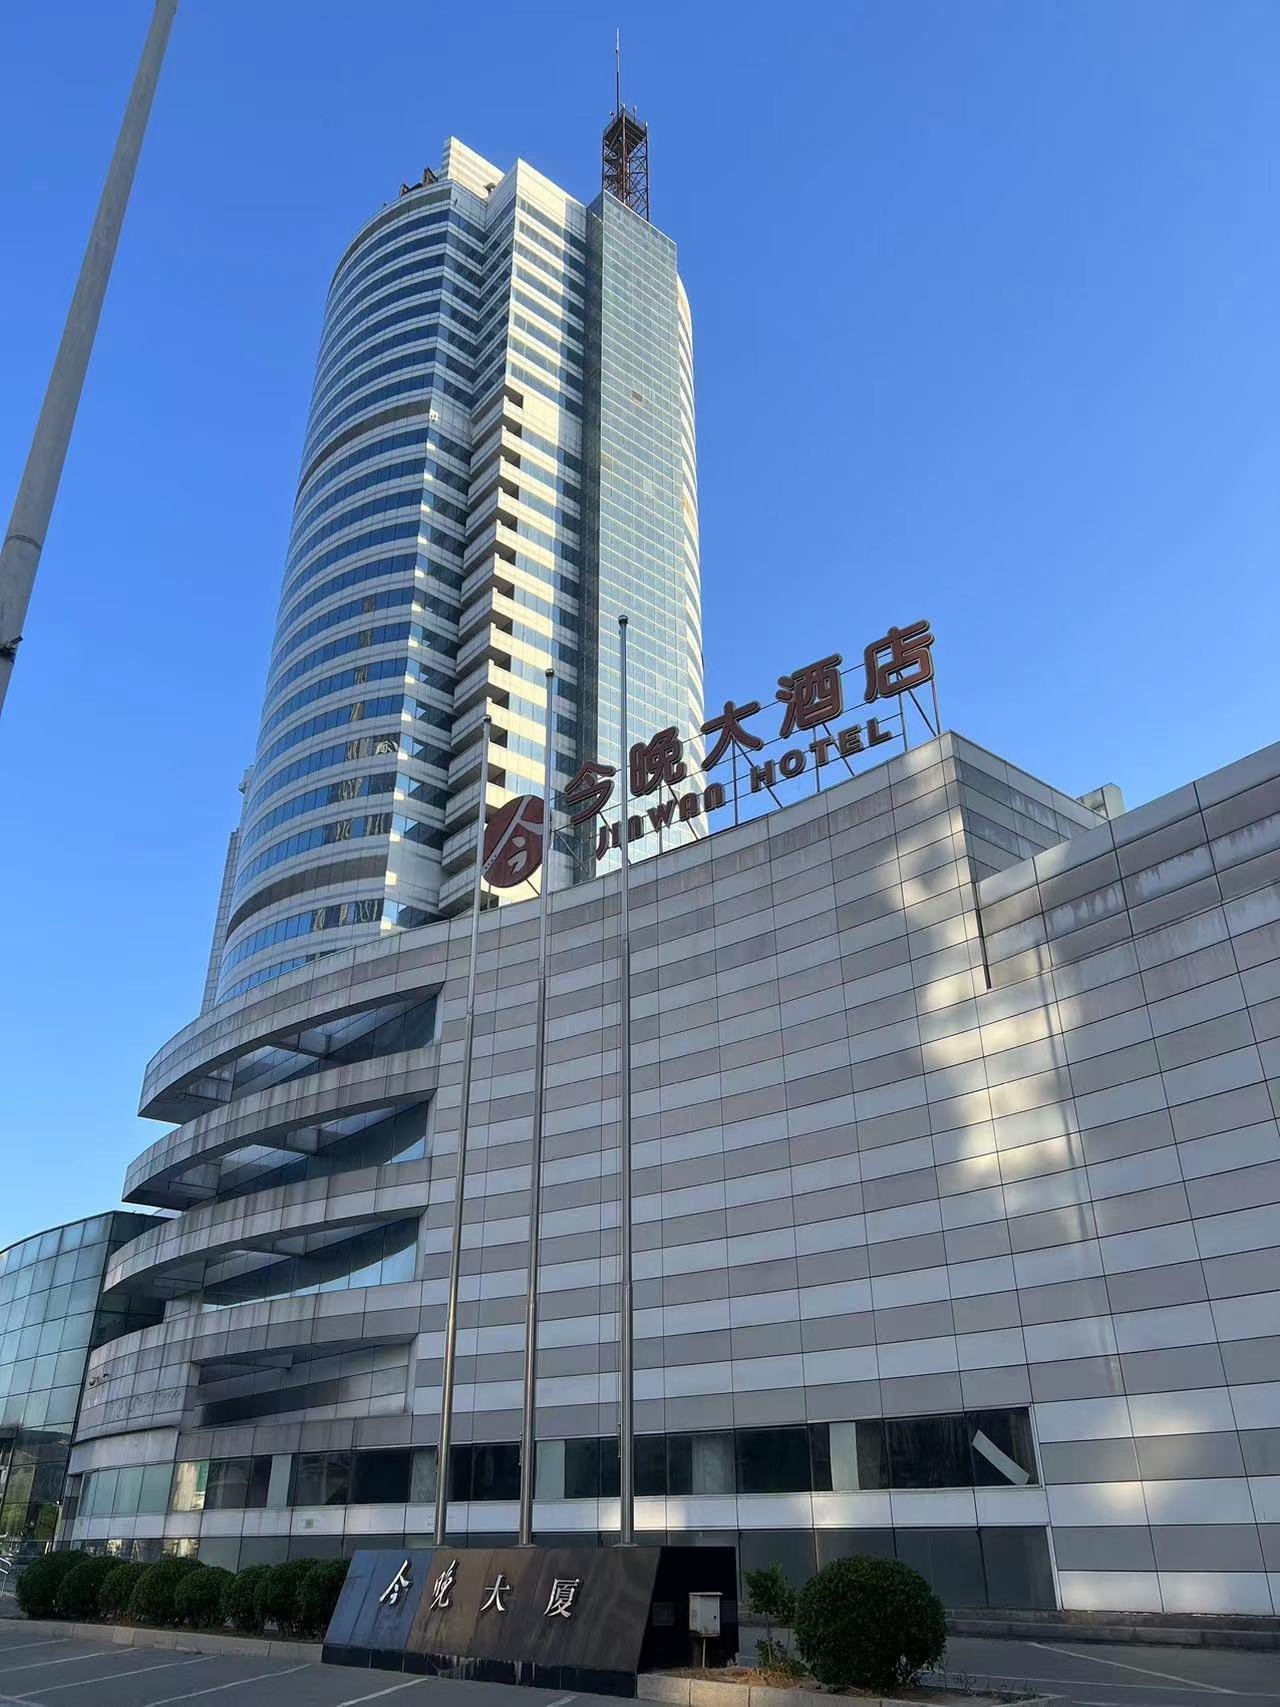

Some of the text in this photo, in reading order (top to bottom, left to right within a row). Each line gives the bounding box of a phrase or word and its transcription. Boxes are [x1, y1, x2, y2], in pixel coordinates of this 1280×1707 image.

[564, 619, 935, 825] 今晚大酒店
[750, 716, 893, 793] HOTEL
[379, 1559, 580, 1618] 今晚大厦
